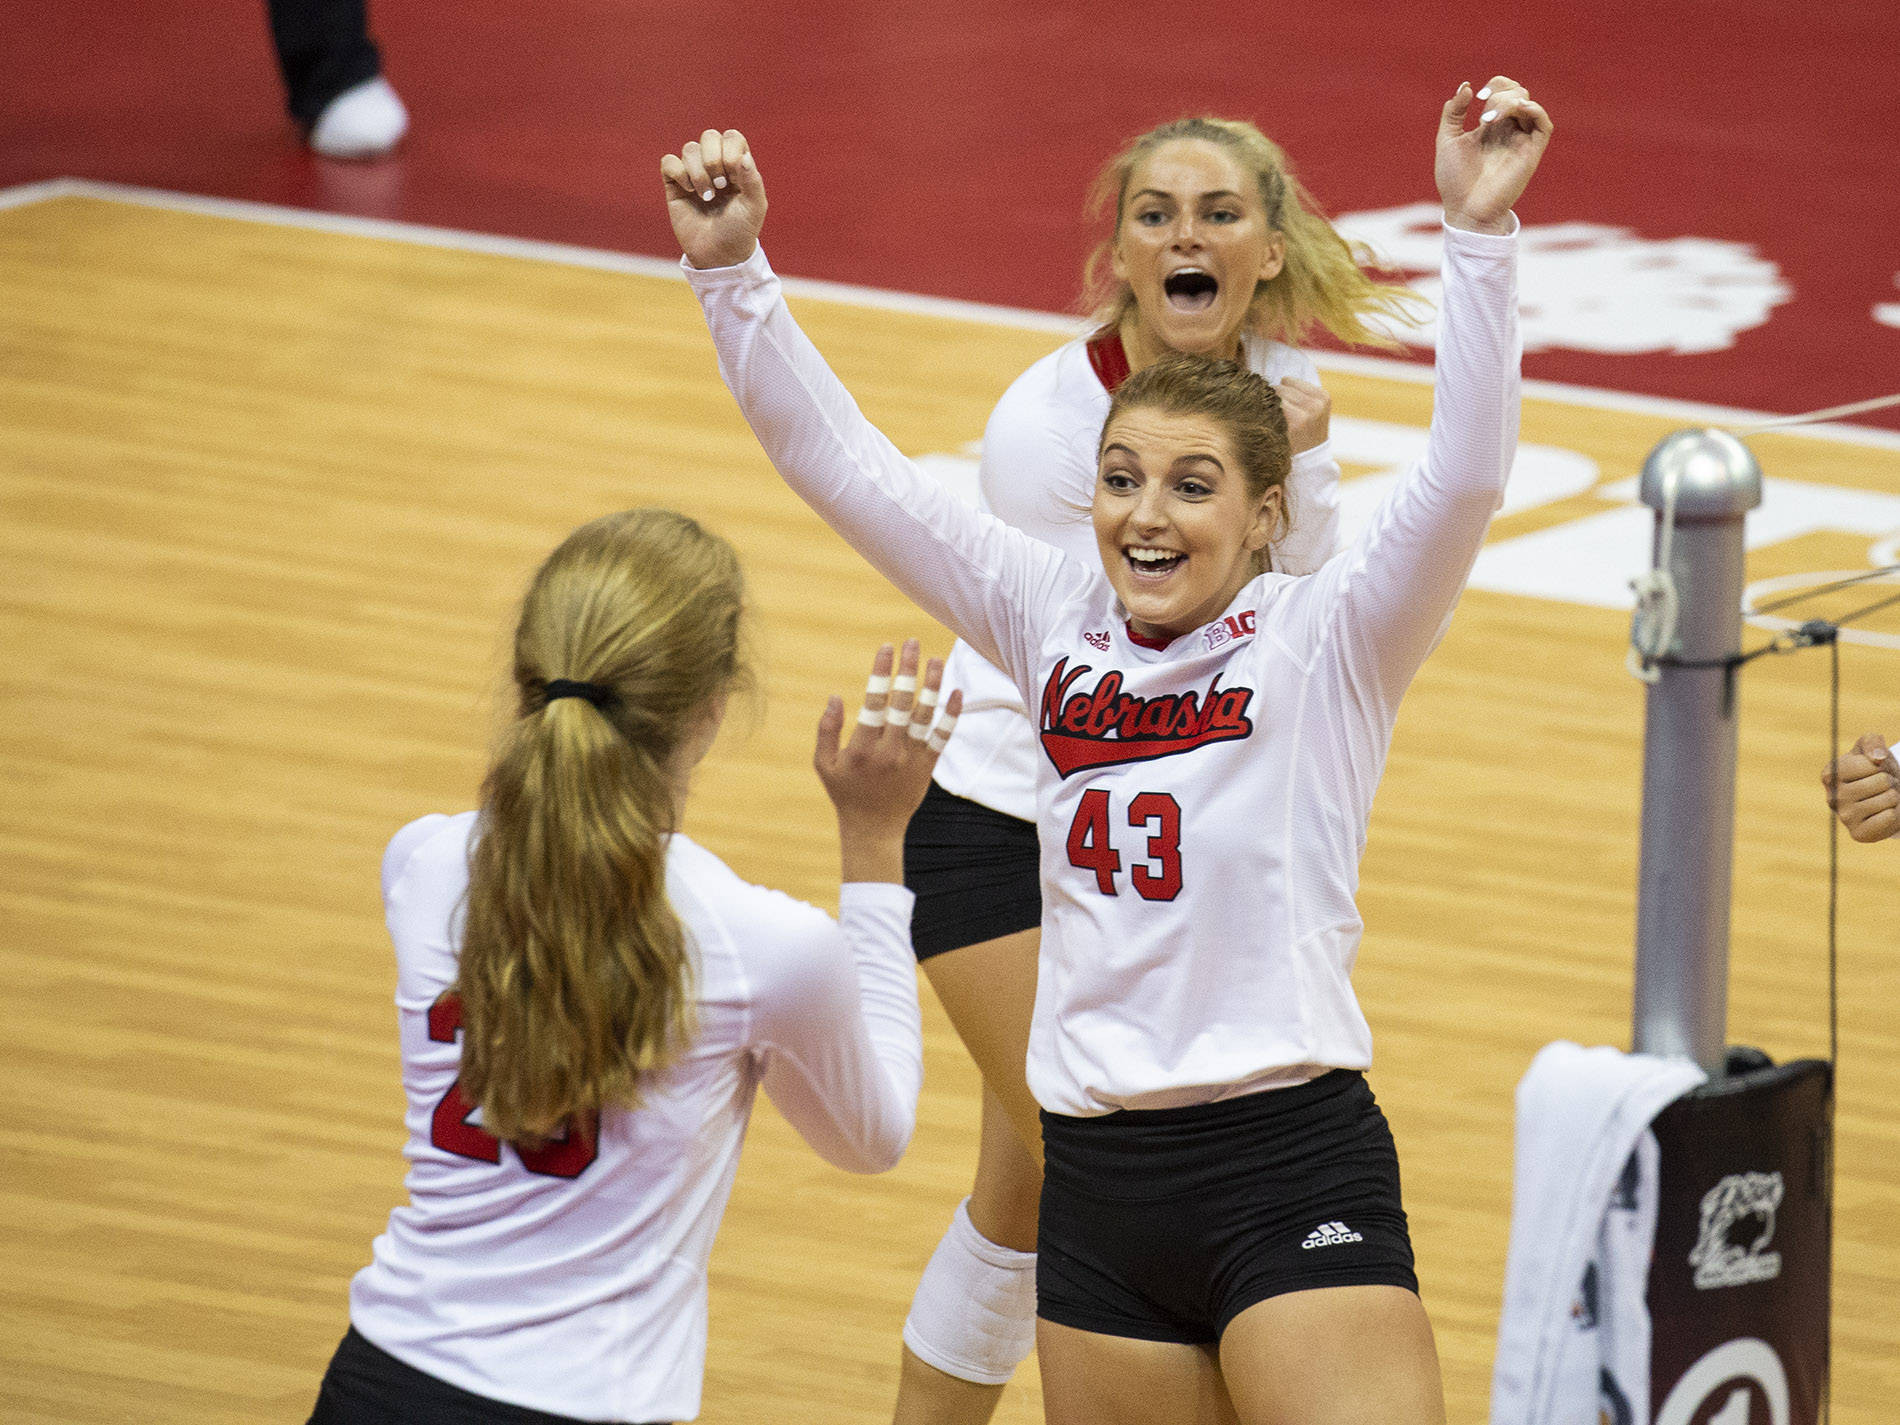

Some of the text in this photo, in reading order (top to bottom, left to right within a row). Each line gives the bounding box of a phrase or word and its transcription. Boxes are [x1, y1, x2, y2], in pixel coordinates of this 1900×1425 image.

[1083, 631, 1110, 652] adidas
[1066, 788, 1183, 902] 43
[1301, 1231, 1363, 1250] adidas
